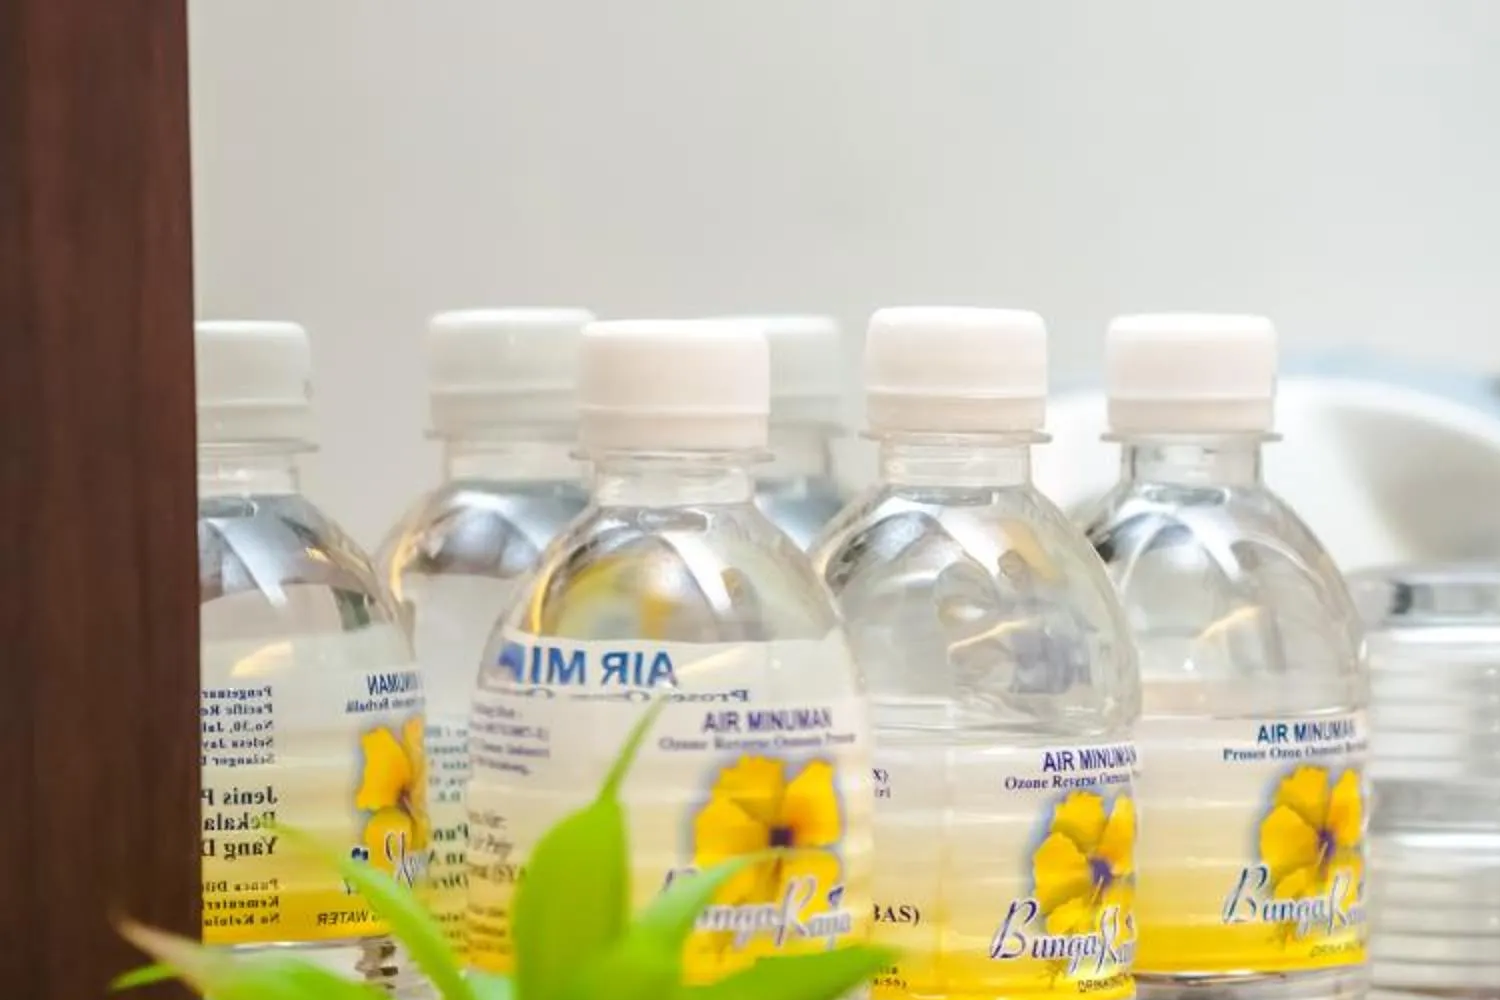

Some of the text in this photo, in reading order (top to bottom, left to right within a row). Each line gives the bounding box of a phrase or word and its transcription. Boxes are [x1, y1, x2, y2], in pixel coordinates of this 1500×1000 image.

[702, 711, 741, 733] AIR
[1257, 724, 1289, 744] AIR
[1043, 751, 1075, 772] AIR
[1004, 776, 1049, 790] Ozone
